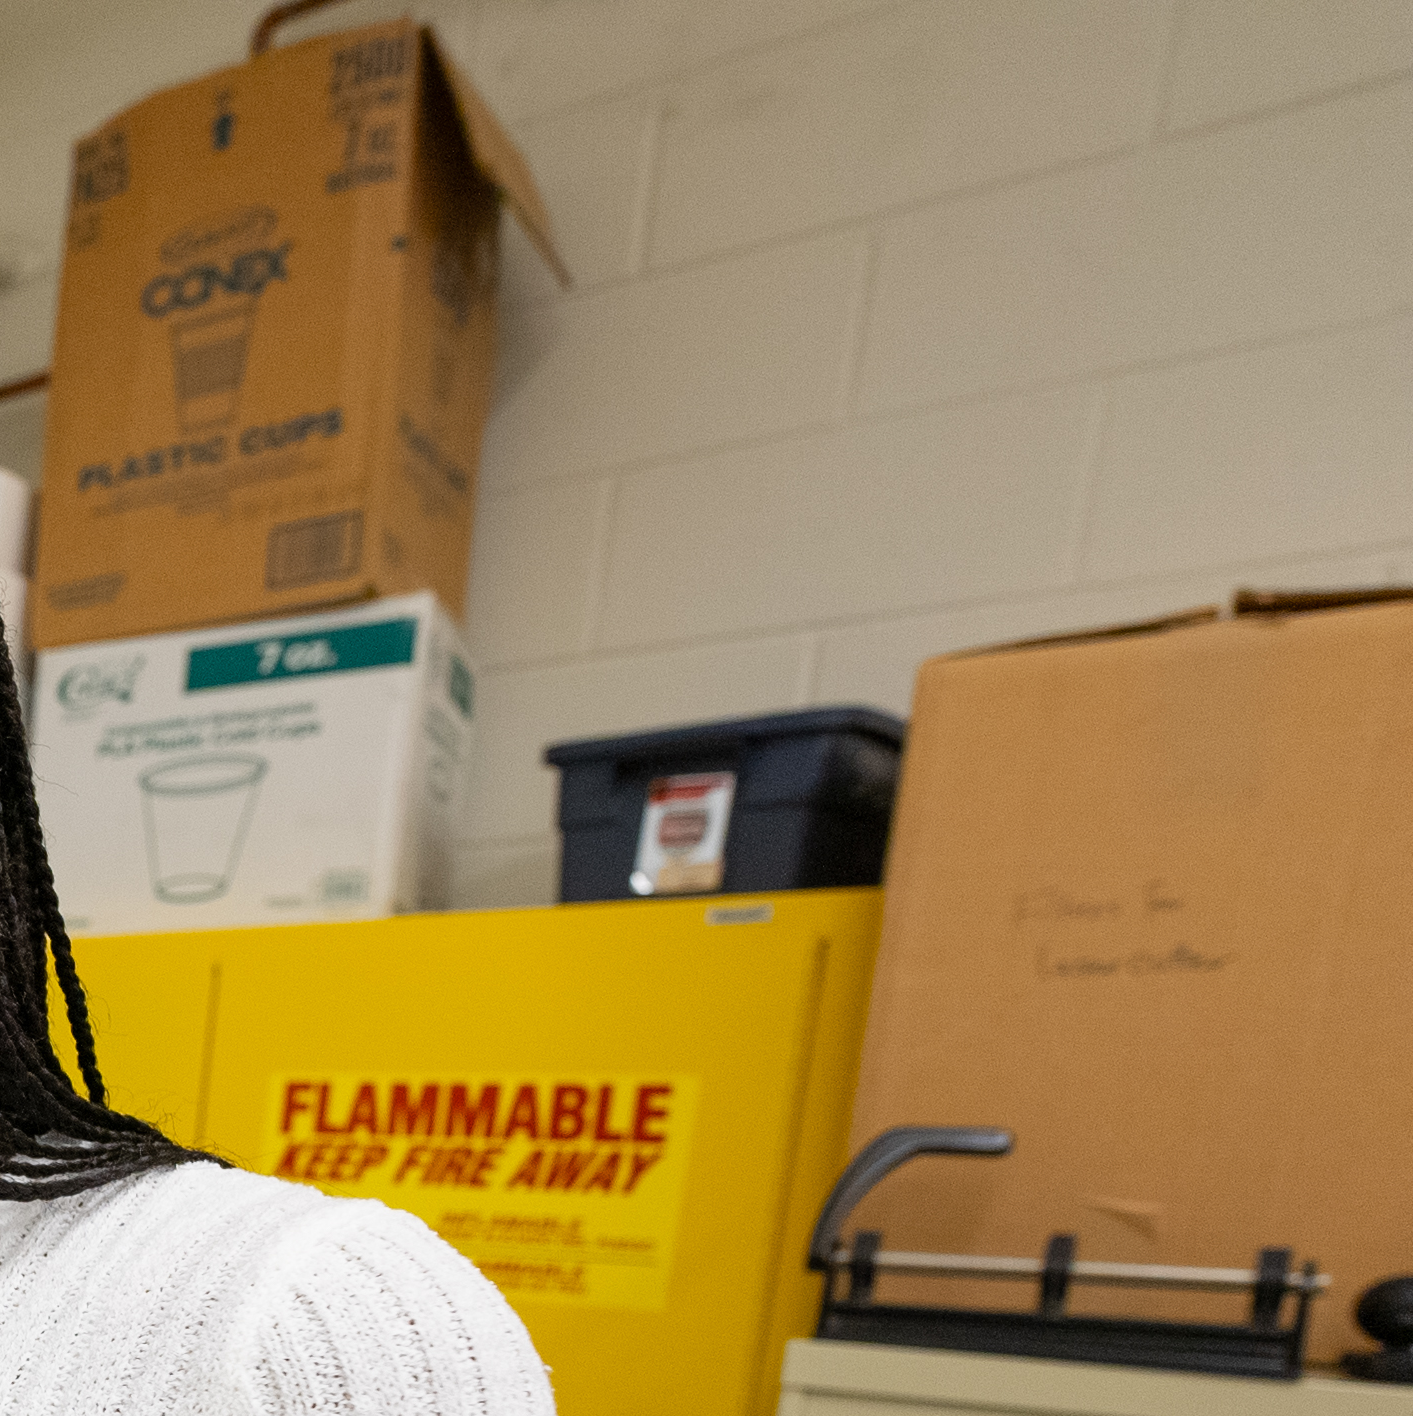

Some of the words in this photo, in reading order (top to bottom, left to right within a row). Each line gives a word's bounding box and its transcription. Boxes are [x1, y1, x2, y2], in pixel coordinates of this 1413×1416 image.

[139, 239, 294, 320] CONEX
[77, 434, 228, 491] PLASTIC
[238, 408, 344, 456] CUPS
[256, 638, 284, 677] 7
[279, 1079, 675, 1144] FLAMMABLE
[275, 1142, 390, 1184] KEEP
[392, 1146, 504, 1188] FIRE
[506, 1147, 664, 1196] AWAY
